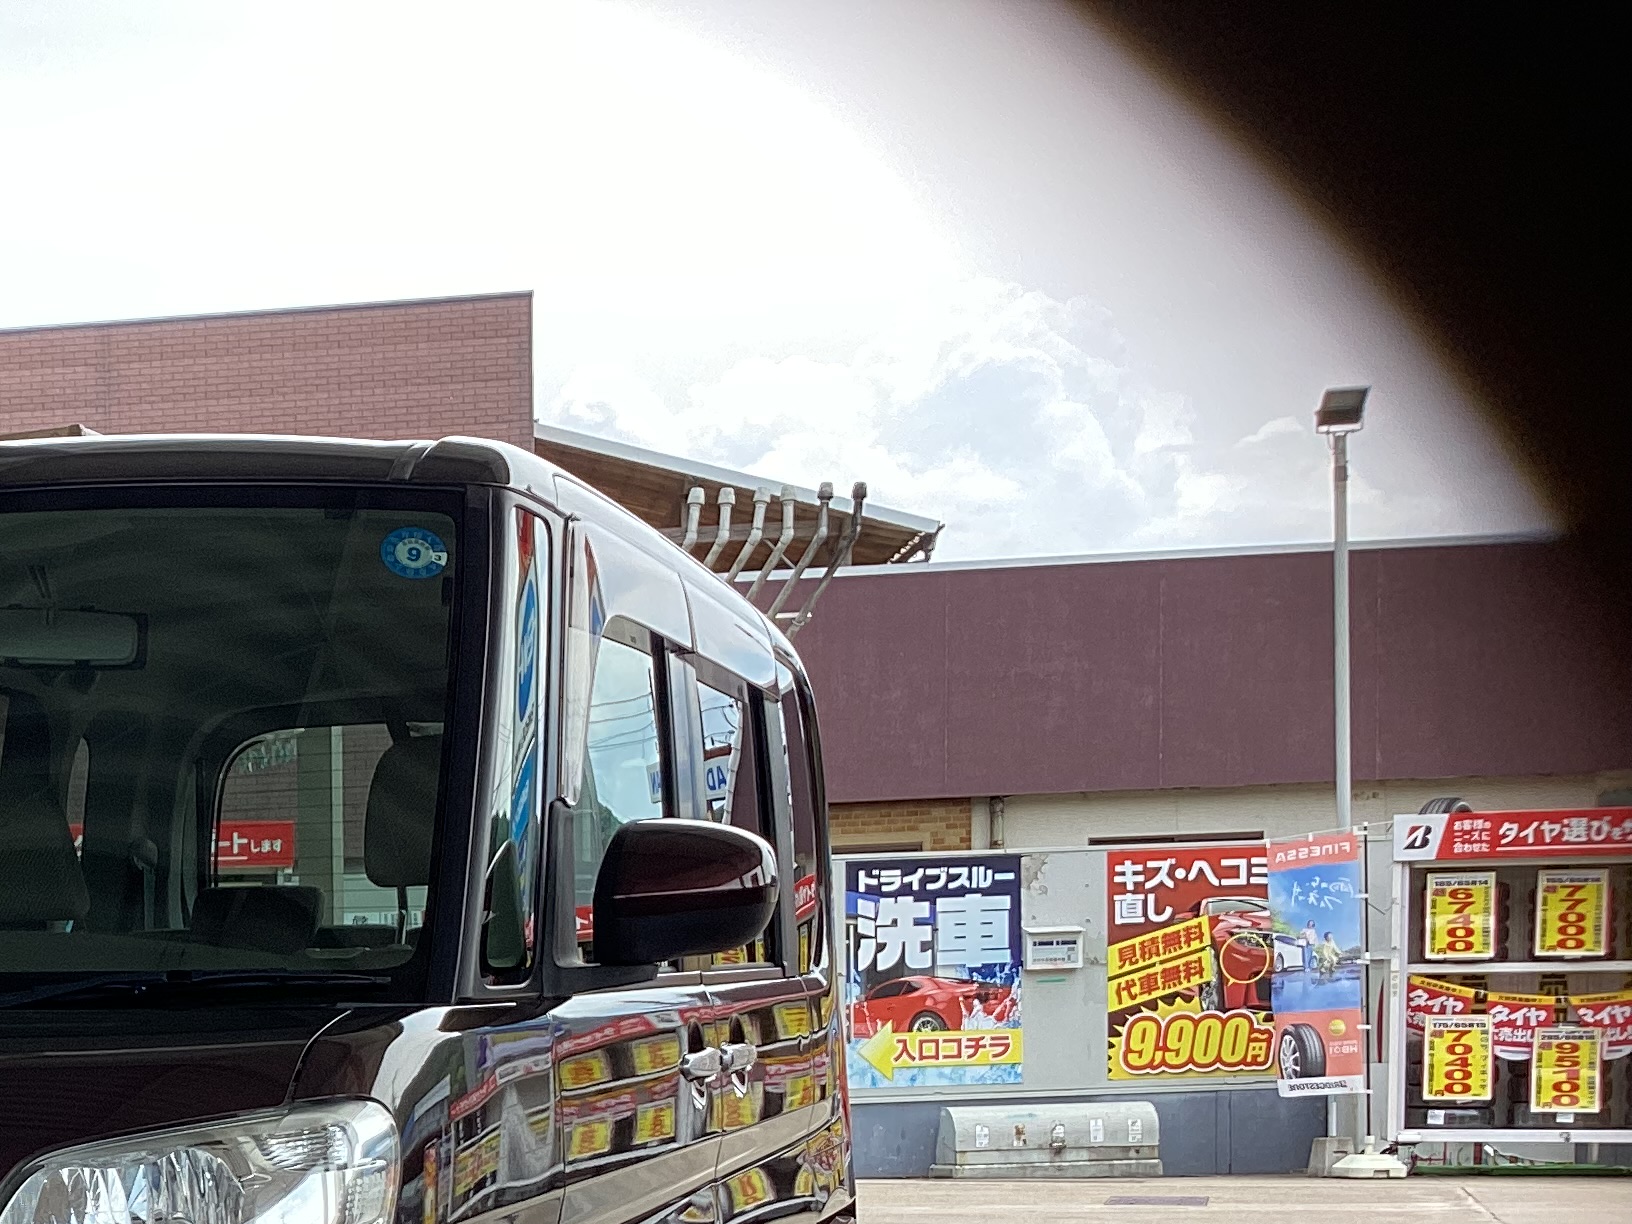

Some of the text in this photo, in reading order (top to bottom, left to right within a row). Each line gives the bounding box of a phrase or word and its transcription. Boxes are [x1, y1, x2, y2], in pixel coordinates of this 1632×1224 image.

[406, 546, 422, 562] 9
[857, 866, 1016, 893] ドライブスルー
[1113, 892, 1173, 925] 直し
[857, 893, 1012, 972] 洗車
[1117, 921, 1205, 970] 見積無料
[1115, 956, 1205, 1006] 代車無料
[1408, 988, 1465, 1015] タイヤ
[1488, 1004, 1548, 1027] タイヤ
[891, 1034, 1013, 1064] 入口コチラ
